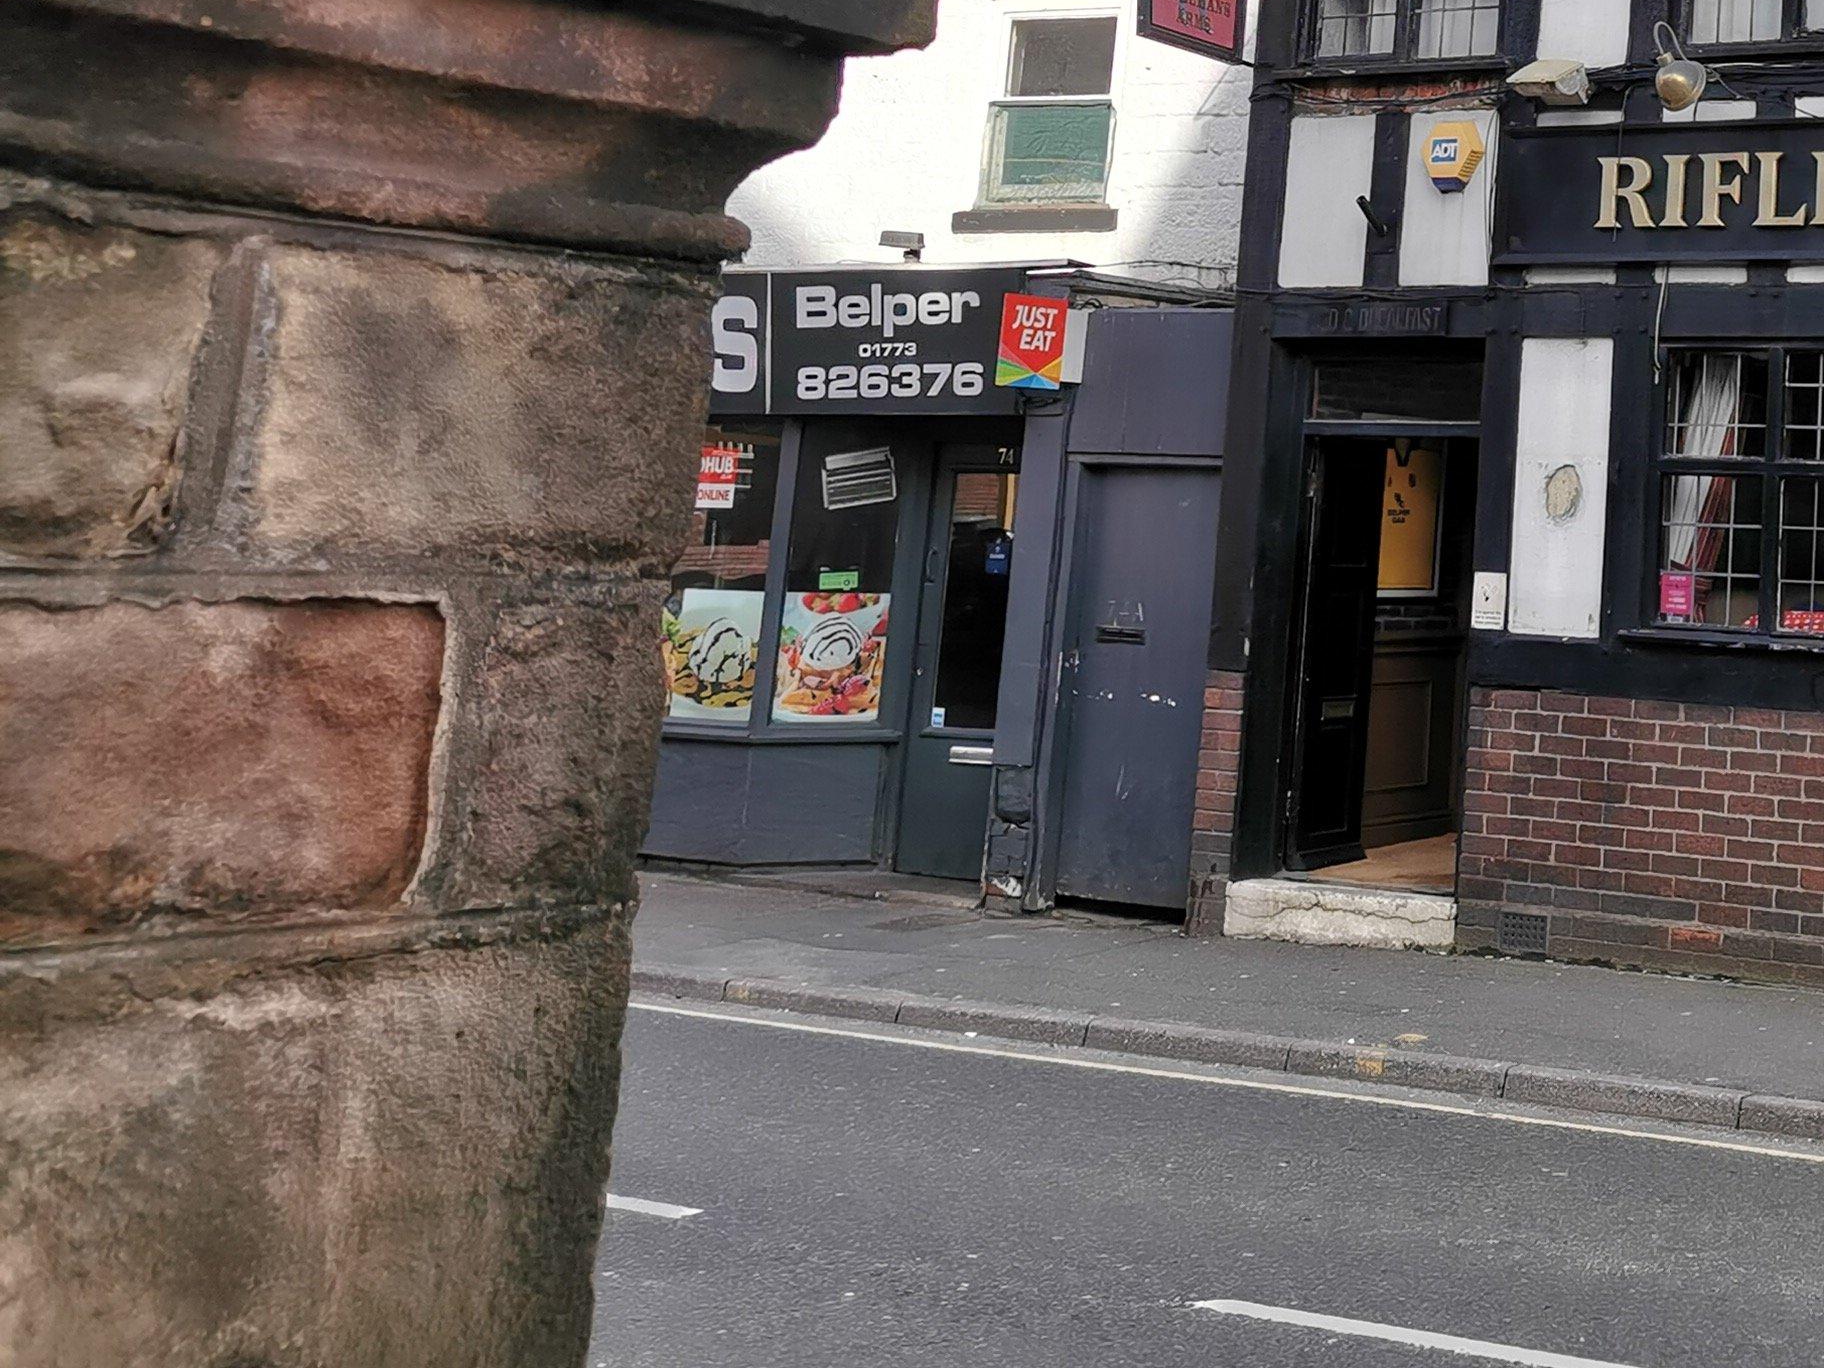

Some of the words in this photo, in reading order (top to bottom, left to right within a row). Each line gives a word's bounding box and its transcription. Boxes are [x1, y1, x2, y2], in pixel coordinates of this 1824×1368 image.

[1431, 141, 1459, 159] ADT
[796, 283, 981, 337] Belper
[1012, 305, 1058, 329] JUST
[858, 342, 917, 358] 01773
[1019, 328, 1057, 351] EAT
[796, 362, 984, 400] 826376
[998, 447, 1014, 464] 74
